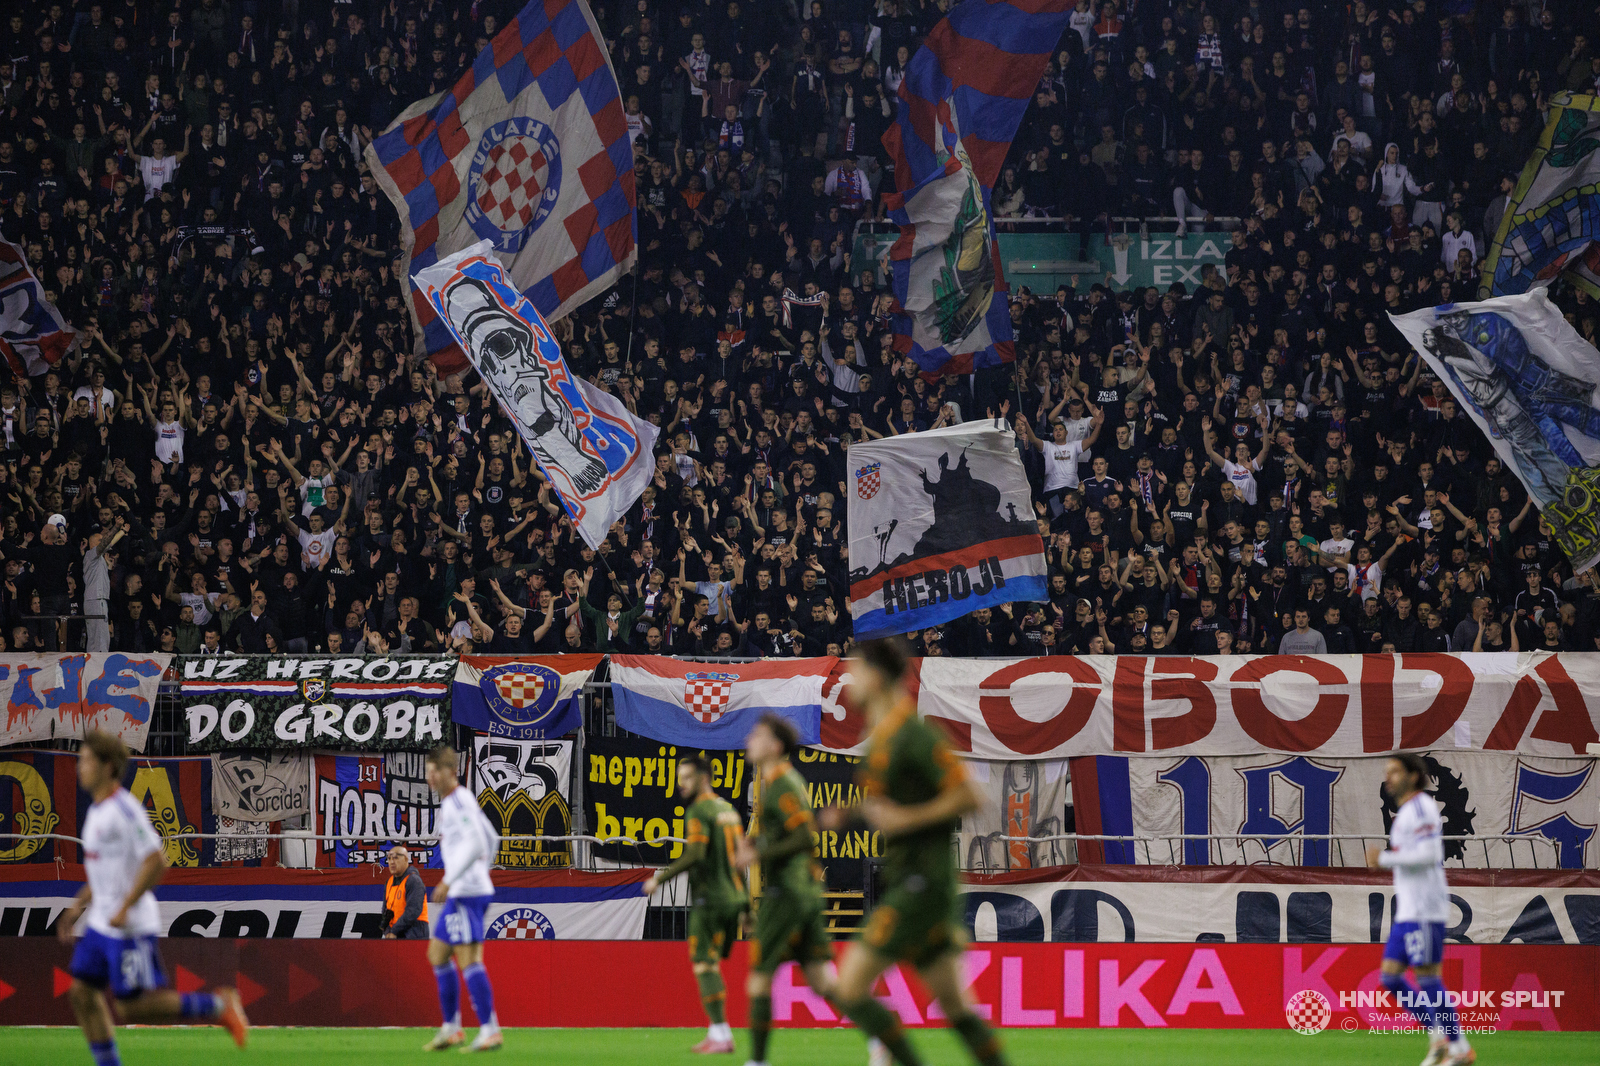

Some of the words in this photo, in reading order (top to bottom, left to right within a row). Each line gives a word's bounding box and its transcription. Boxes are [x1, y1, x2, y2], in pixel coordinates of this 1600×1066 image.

[883, 556, 1006, 615] HEROJI
[184, 658, 250, 680] UZ
[266, 657, 458, 681] HEROJE
[185, 700, 256, 744] DO
[274, 702, 443, 743] GROBA
[489, 697, 542, 721] SPLIT
[589, 746, 746, 799] neprijelj
[318, 776, 441, 854] TORCID
[348, 850, 432, 864] SPIT
[490, 907, 552, 933] HAJDUK
